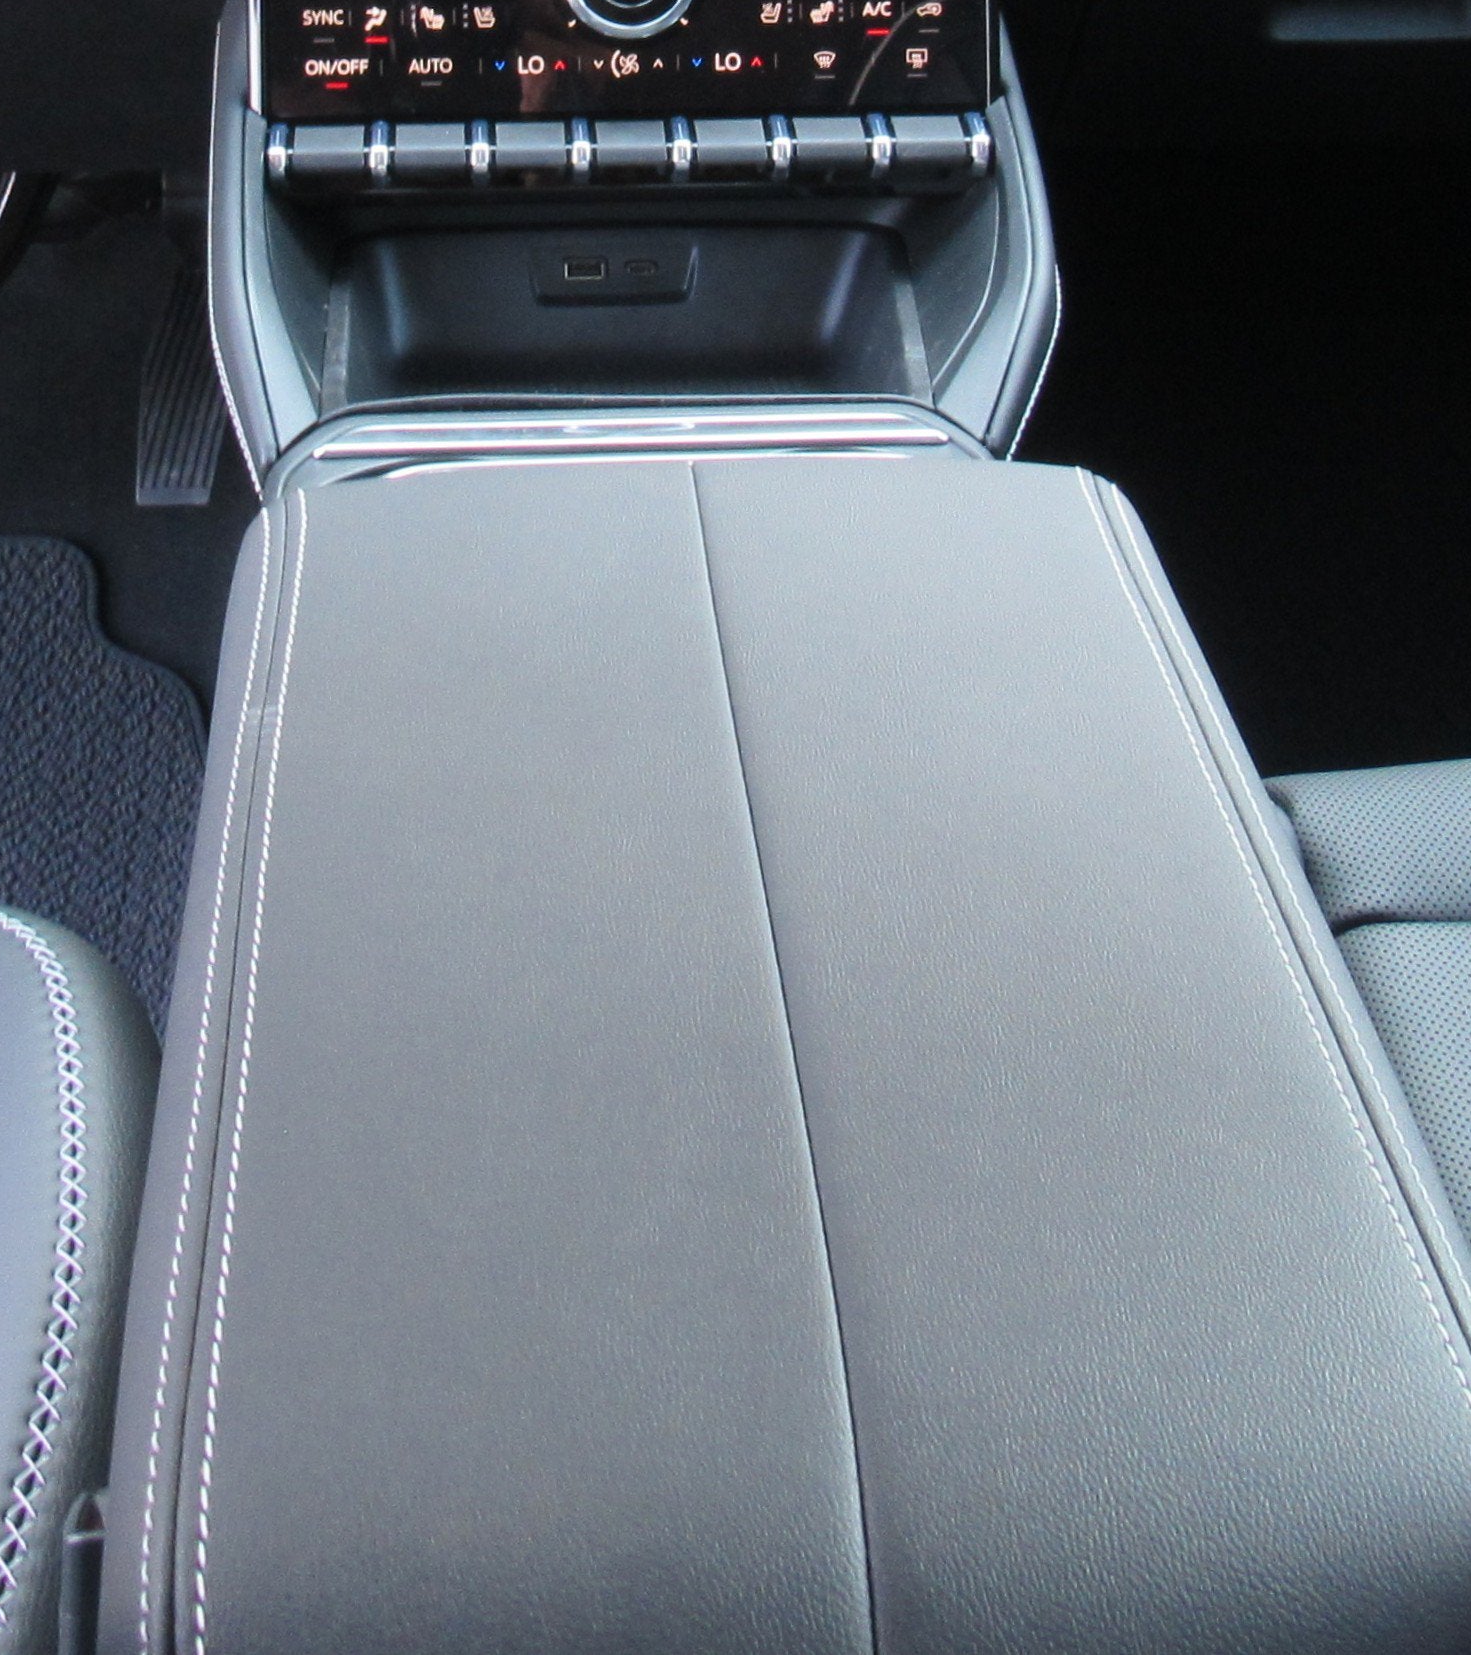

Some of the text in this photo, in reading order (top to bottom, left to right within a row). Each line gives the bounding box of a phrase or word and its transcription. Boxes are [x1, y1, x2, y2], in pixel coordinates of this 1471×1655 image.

[863, 1, 891, 16] A/C
[303, 10, 343, 25] SYNC
[305, 59, 368, 75] ON/OFF
[409, 58, 452, 74] AUTO
[518, 56, 544, 75] LO
[715, 53, 741, 71] LO
